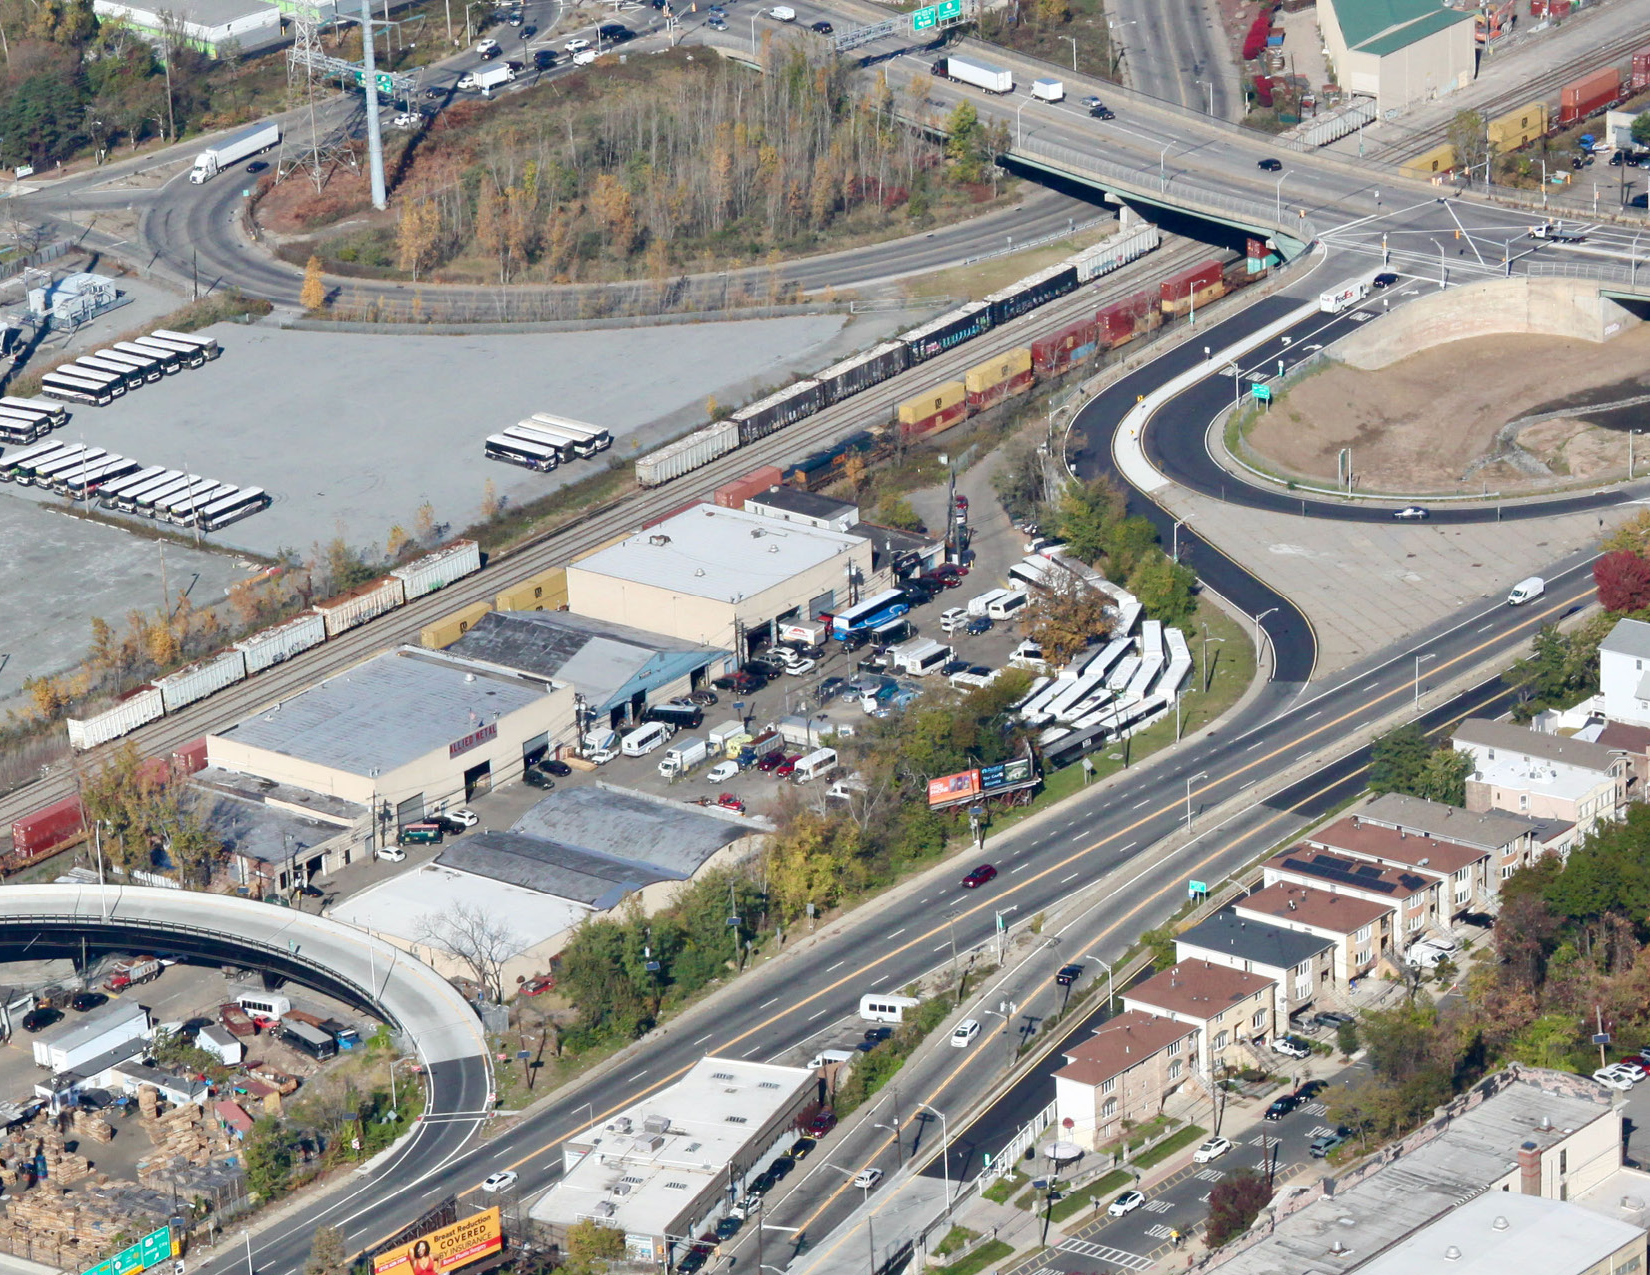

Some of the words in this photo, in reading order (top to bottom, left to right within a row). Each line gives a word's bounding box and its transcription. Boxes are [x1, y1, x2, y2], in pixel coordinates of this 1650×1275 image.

[1335, 290, 1354, 304] FedEx
[450, 735, 473, 753] ALLIED
[476, 723, 496, 741] METAL
[1248, 1134, 1283, 1149] SLOW
[1194, 1168, 1226, 1182] SLOW
[1141, 1199, 1175, 1214] SLOW
[433, 1229, 456, 1244] Breast
[457, 1214, 492, 1233] Reduction
[440, 1225, 486, 1250] COVERED
[1144, 1223, 1174, 1240] SLOW
[439, 1249, 449, 1260] BY
[450, 1232, 492, 1255] INSURANCE
